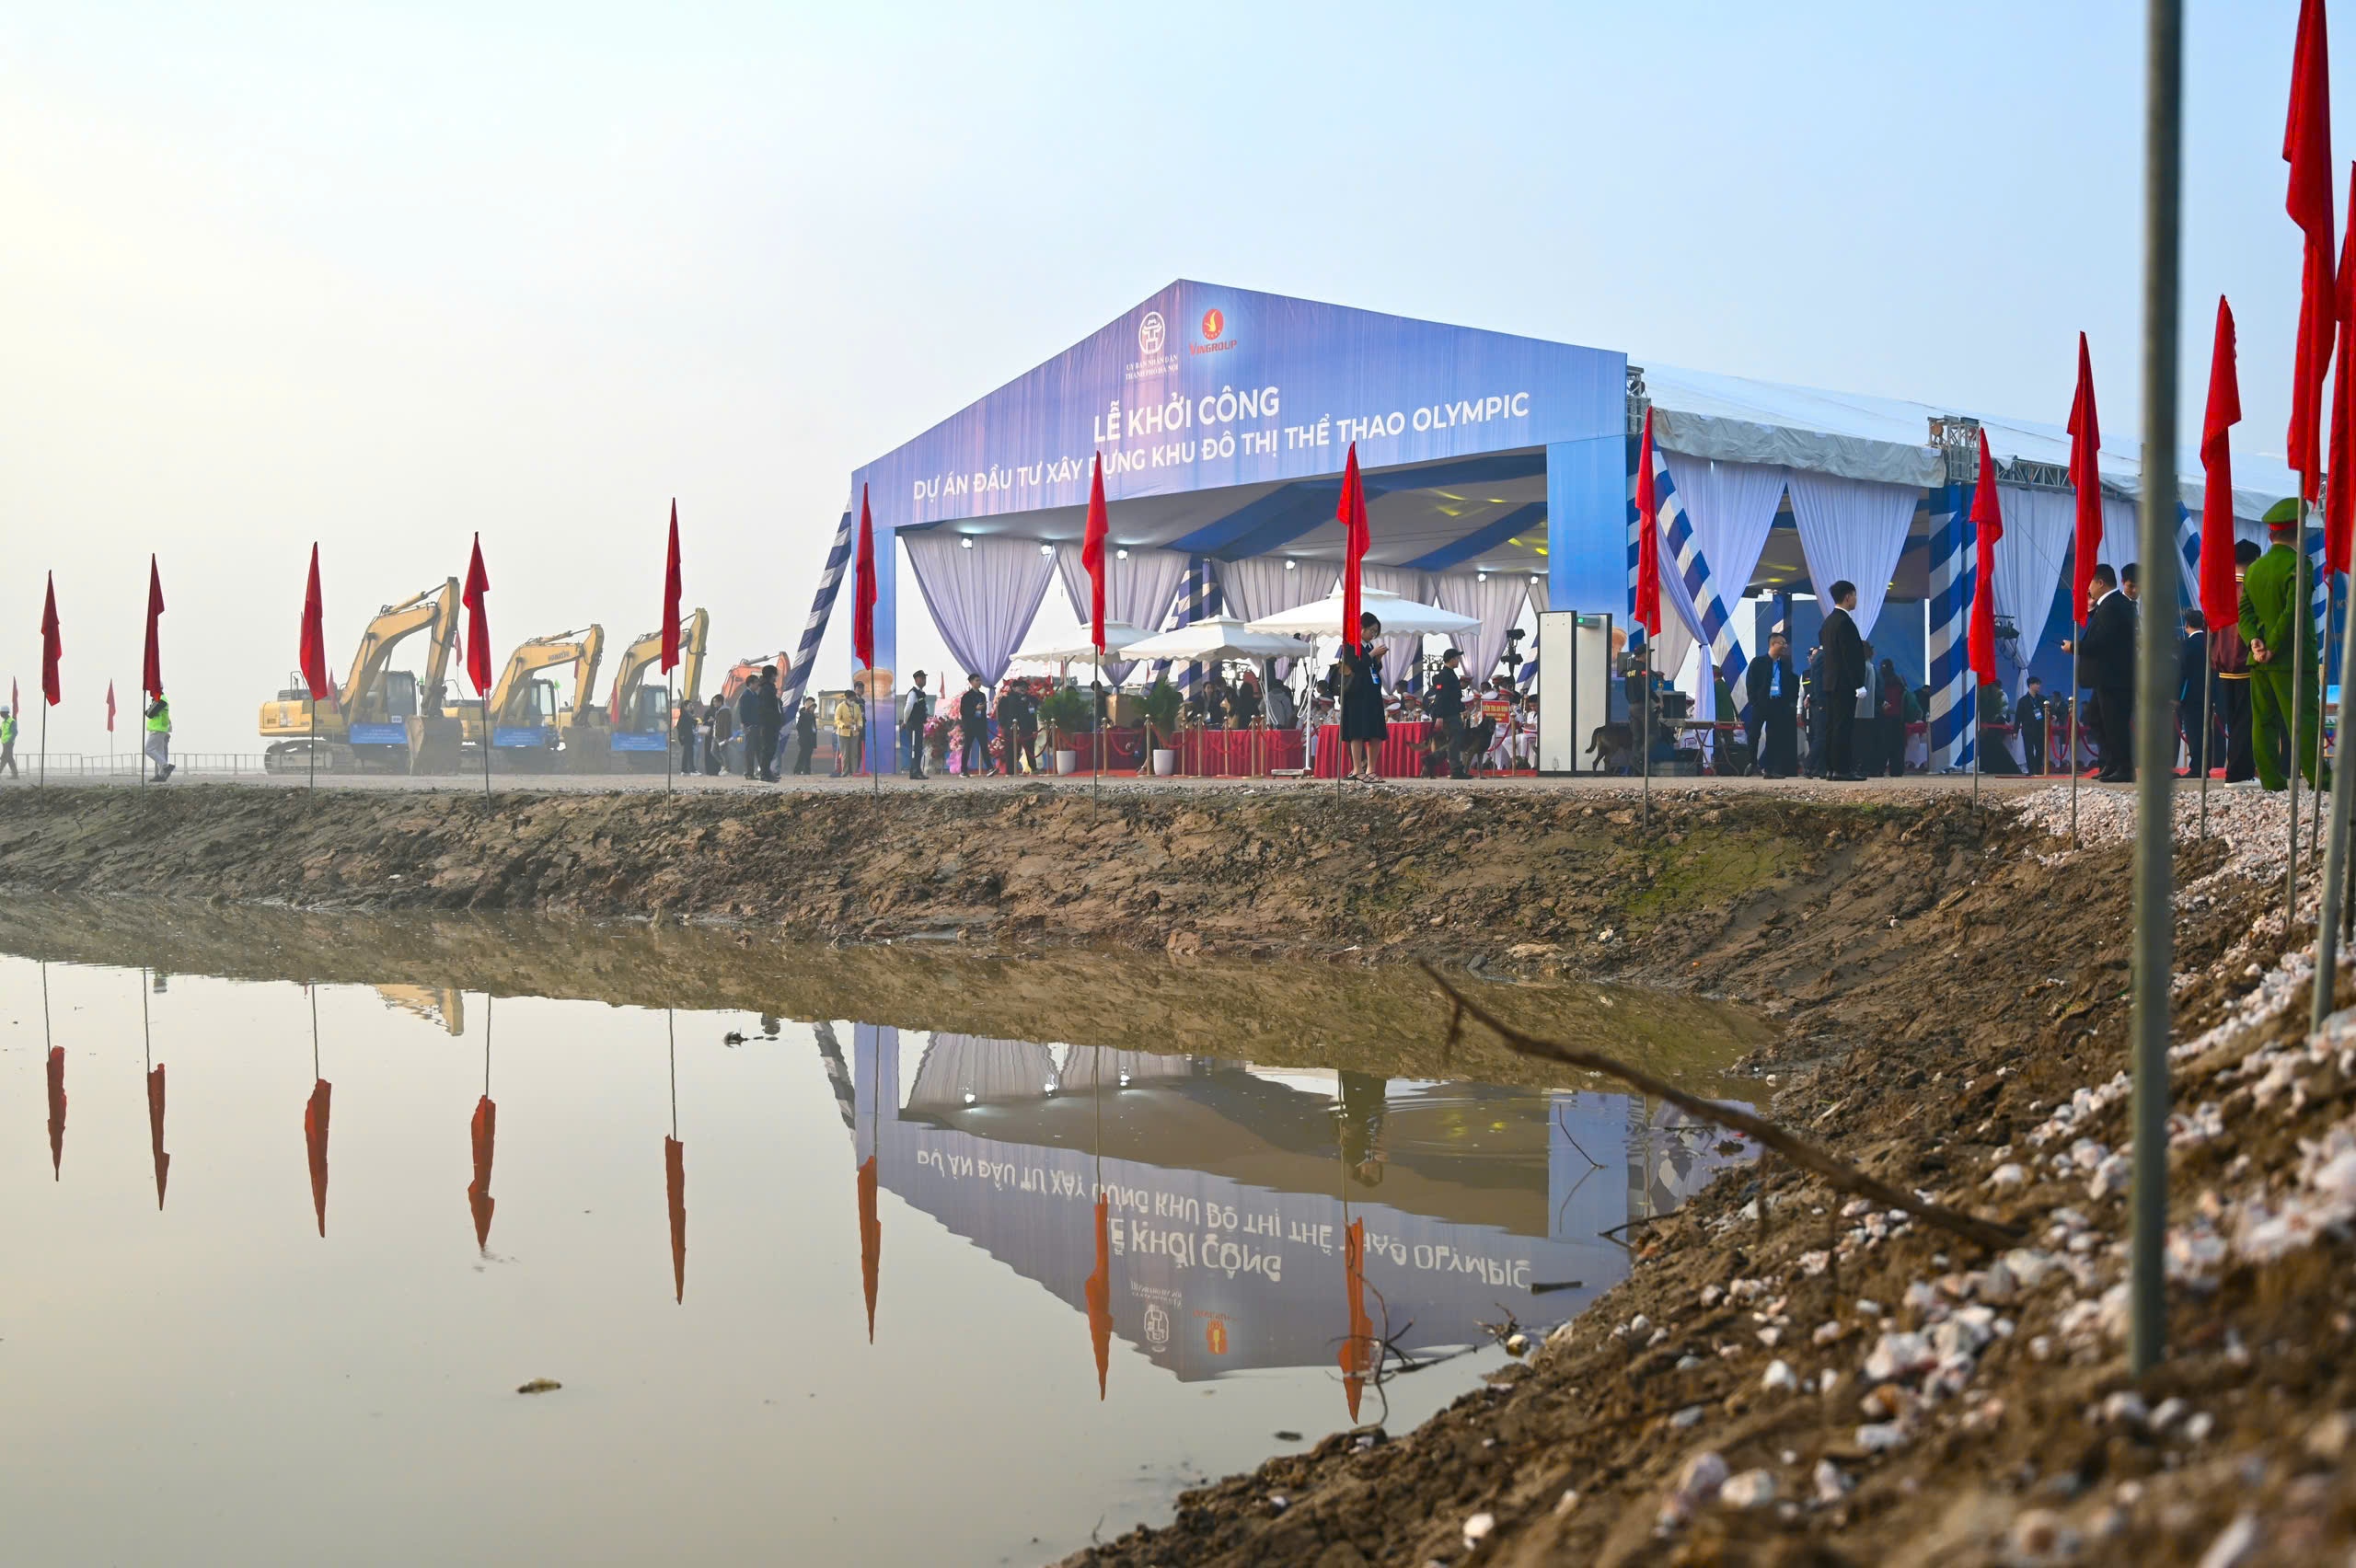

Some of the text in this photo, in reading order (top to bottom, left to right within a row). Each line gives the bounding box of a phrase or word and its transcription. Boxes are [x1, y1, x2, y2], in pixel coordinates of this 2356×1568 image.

[1189, 340, 1238, 355] VINGROUP
[1093, 385, 1279, 443] LỄ KHỞI CÔNG
[913, 475, 941, 503] DỰ
[942, 471, 968, 497] ÁN
[973, 464, 1012, 493] ĐẦU
[1017, 461, 1043, 488] TƯ
[1046, 456, 1084, 484] XÂY
[1152, 441, 1195, 468] KHU
[1201, 430, 1236, 461] ĐÔ
[1242, 429, 1277, 457] THỊ
[1284, 413, 1330, 450] THỂ
[1336, 411, 1405, 444] THAO
[1412, 392, 1530, 432] OLYMPIC
